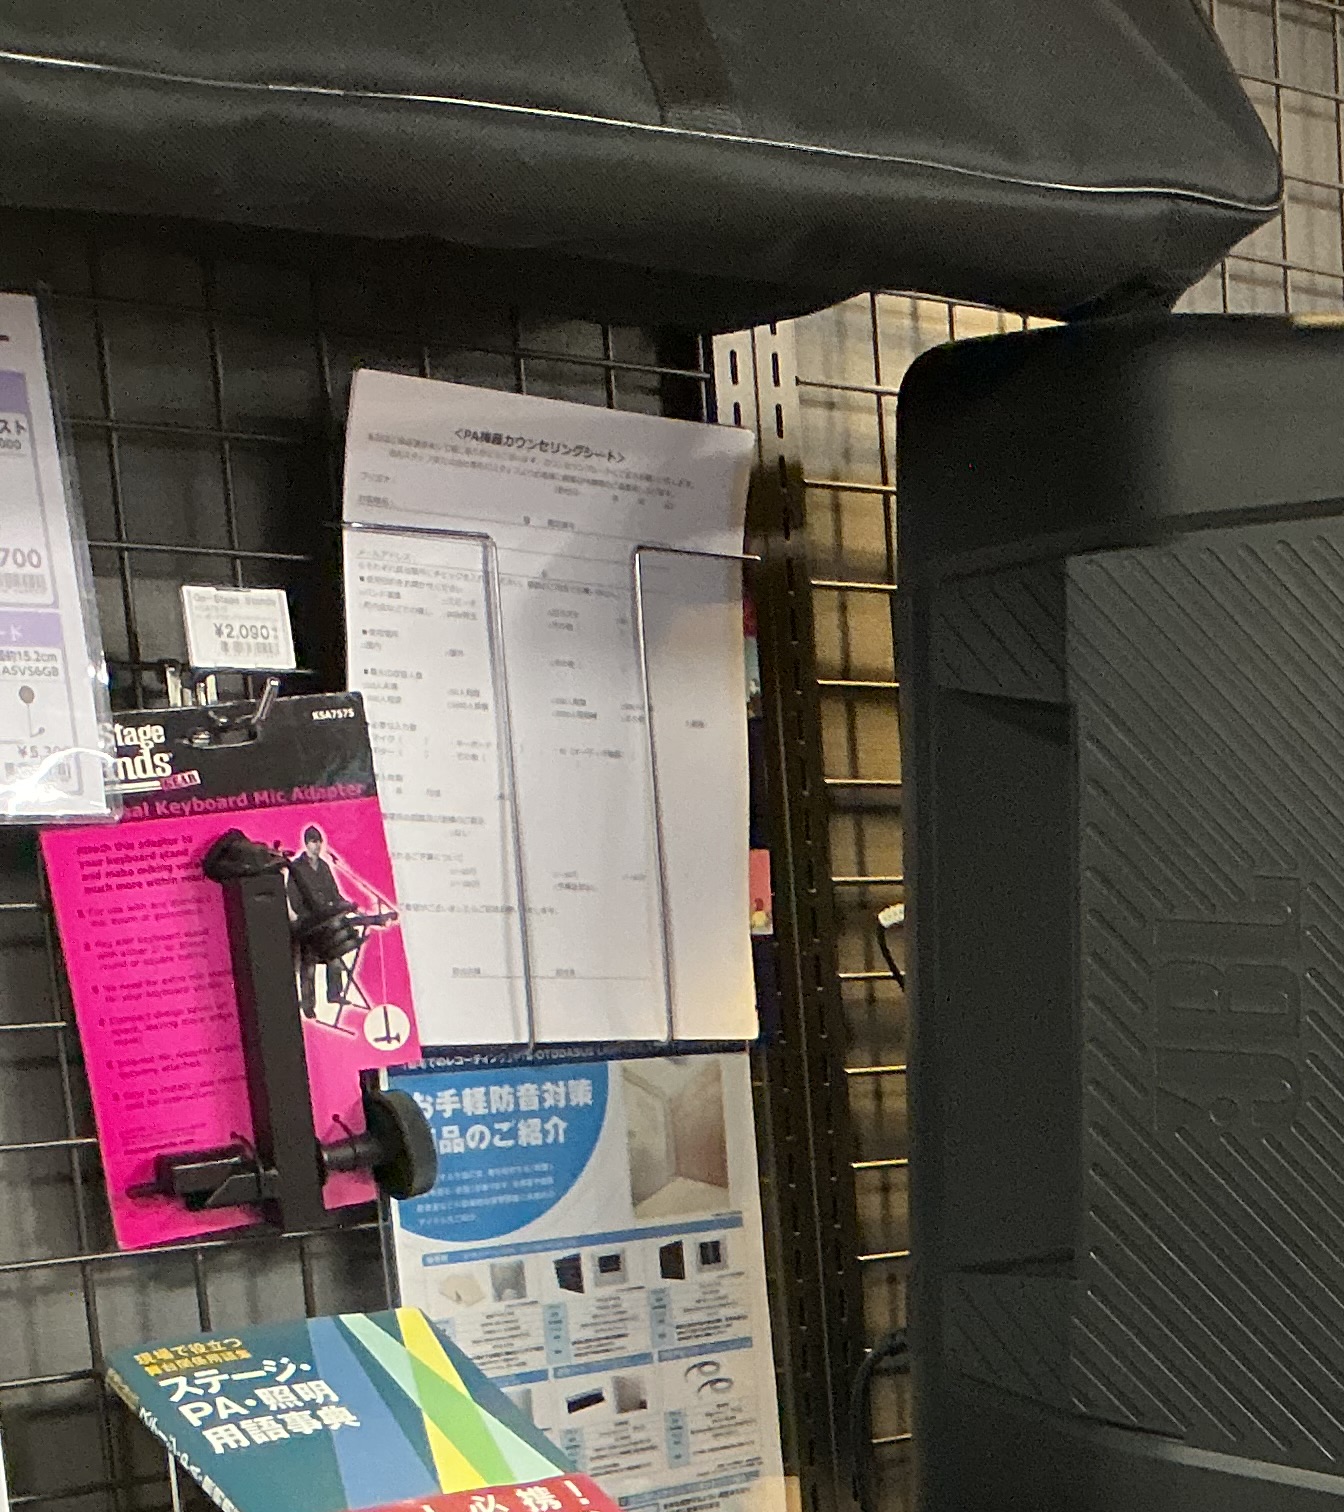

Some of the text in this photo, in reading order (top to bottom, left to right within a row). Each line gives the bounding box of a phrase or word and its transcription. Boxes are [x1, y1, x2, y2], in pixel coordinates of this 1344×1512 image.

[153, 791, 247, 818] Keyboard
[252, 787, 286, 806] Mic
[291, 781, 363, 802] Adapter
[413, 1078, 593, 1121] お手軽防音対策
[431, 1114, 569, 1156] 品のご紹介
[158, 1357, 312, 1403] ステージ・
[178, 1380, 340, 1428] PA・照明
[202, 1404, 361, 1455] 用語事典
